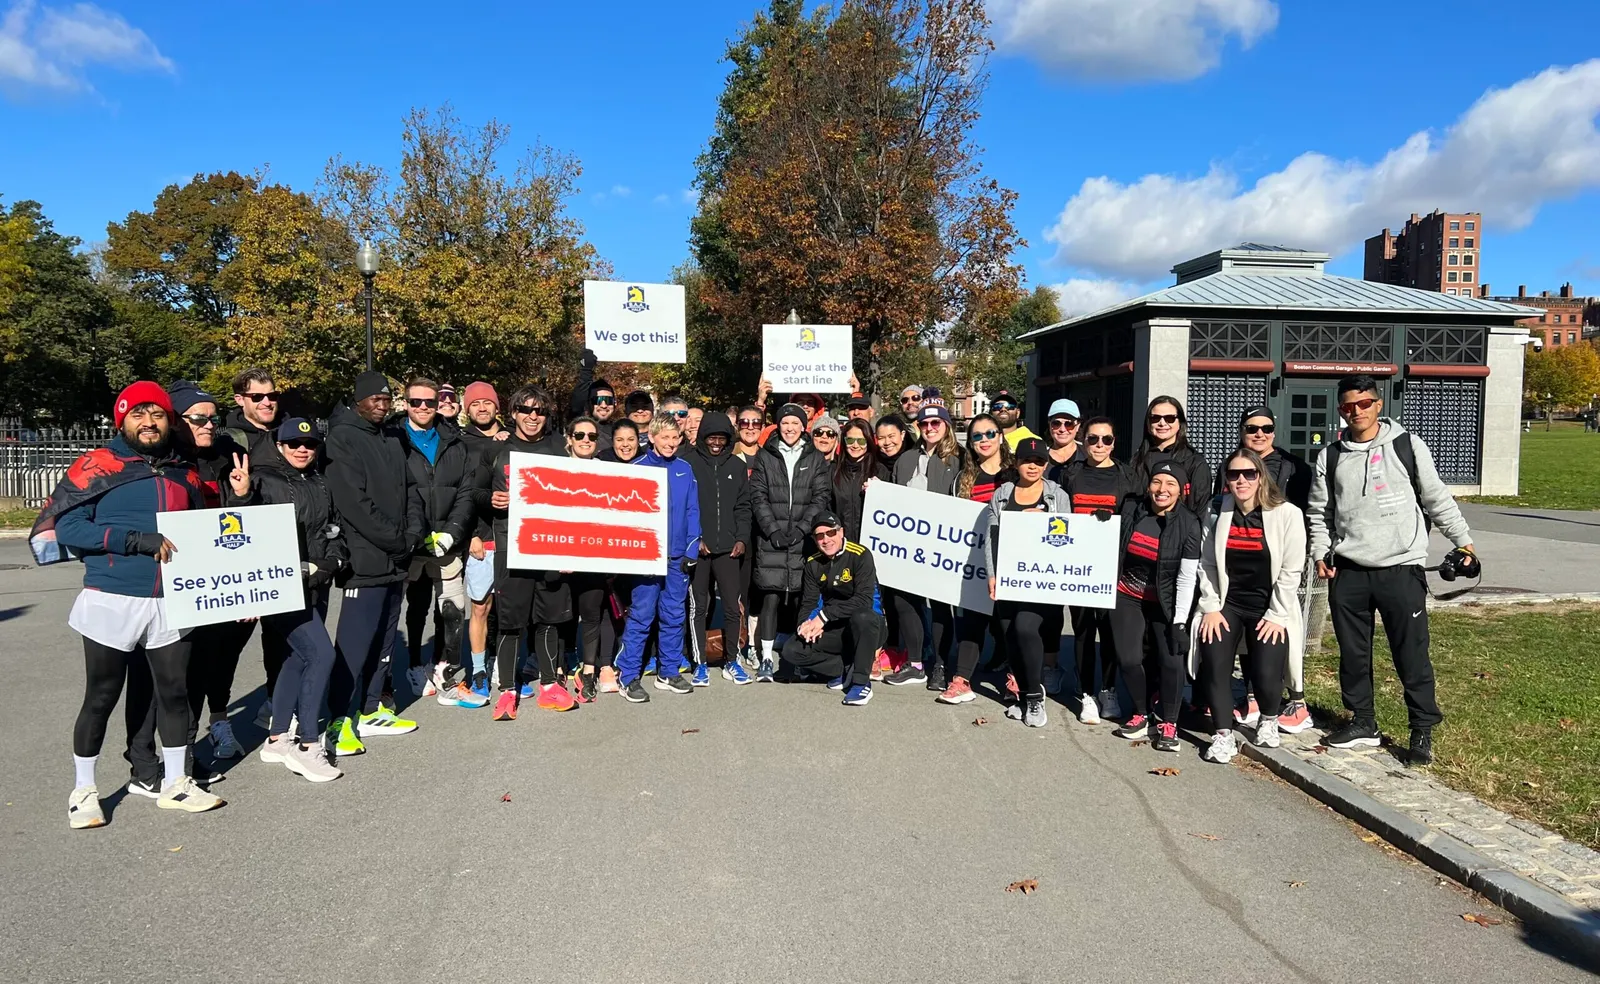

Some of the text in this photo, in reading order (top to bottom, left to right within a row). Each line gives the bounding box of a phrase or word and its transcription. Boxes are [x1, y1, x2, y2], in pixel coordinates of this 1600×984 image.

[594, 330, 678, 344] We got this!
[768, 362, 847, 373] See you at the
[783, 375, 833, 384] start line
[873, 509, 931, 536] GOOD
[531, 534, 647, 549] STRIDE FOR STRIDE
[869, 535, 988, 580] Tom & Jorge
[173, 565, 294, 591] See you at the
[1017, 562, 1093, 577] B.A.A. Half
[1000, 576, 1112, 595] Here we come!!!
[195, 588, 279, 610] finish line
